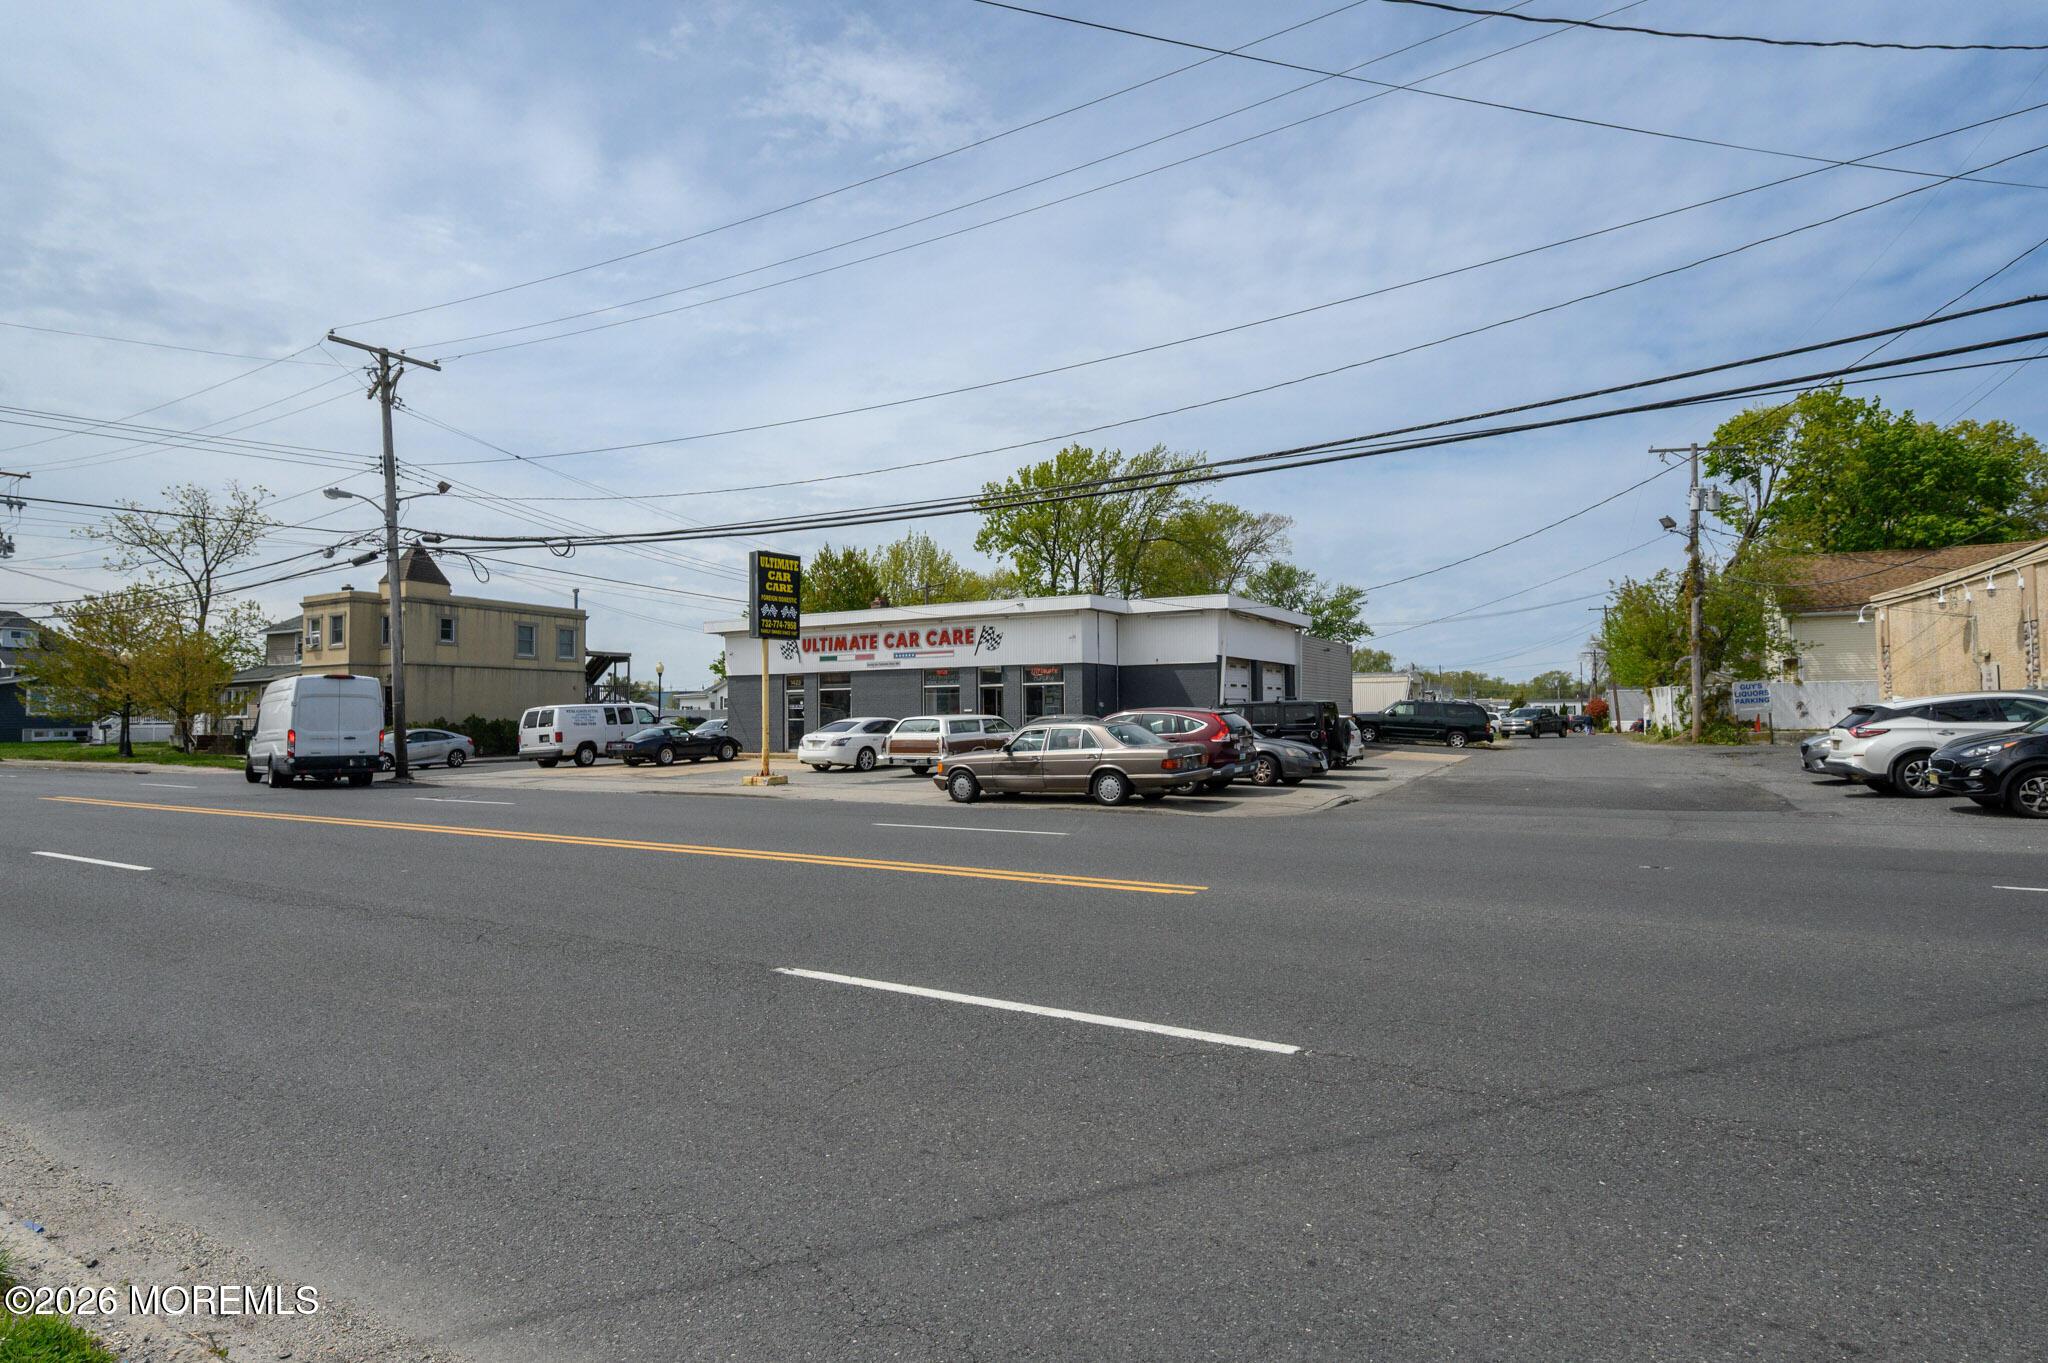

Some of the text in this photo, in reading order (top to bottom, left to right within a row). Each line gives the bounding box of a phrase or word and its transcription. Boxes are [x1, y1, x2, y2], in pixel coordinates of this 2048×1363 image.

[760, 556, 799, 571] ULTIMATE
[768, 570, 791, 582] CAR
[765, 582, 793, 593] CARE
[802, 628, 976, 653] ULTIMATE CAR CARE
[1735, 690, 1770, 698] LIQUORS
[1735, 697, 1770, 705] PARKING
